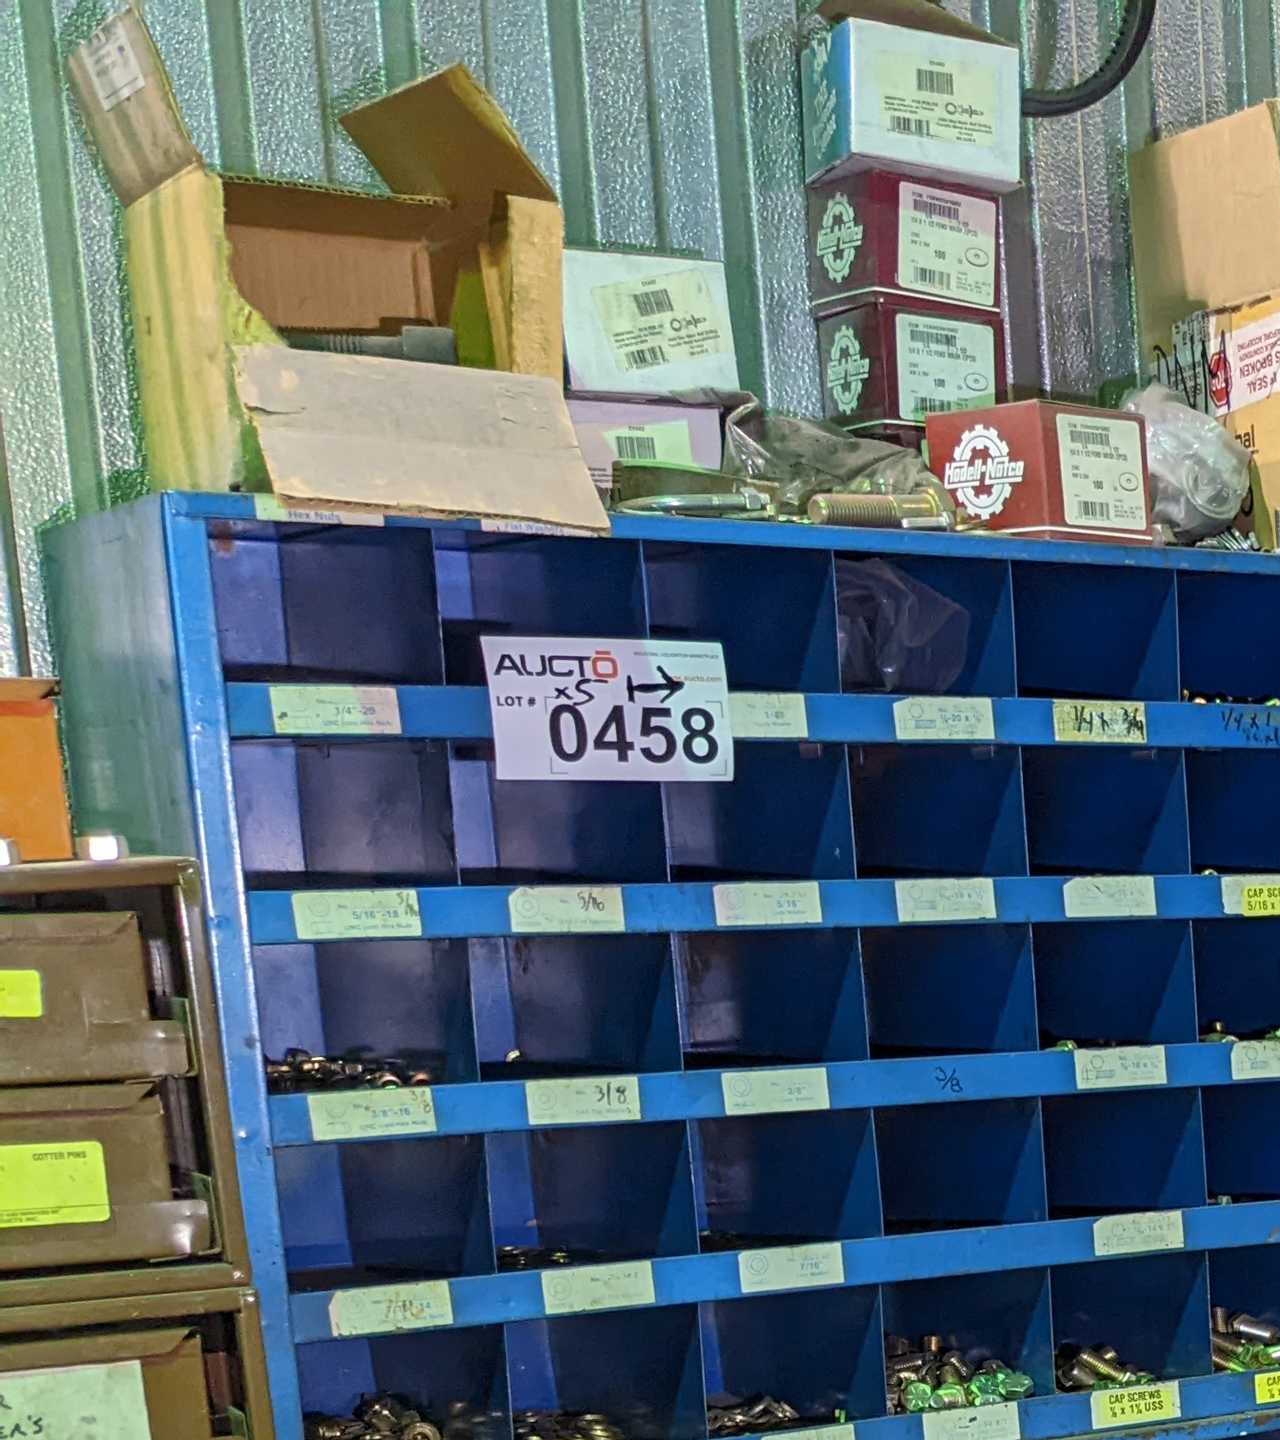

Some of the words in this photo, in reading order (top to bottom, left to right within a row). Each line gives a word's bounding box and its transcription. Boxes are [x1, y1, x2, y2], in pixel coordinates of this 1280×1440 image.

[496, 695, 524, 707] LOT
[527, 695, 537, 707] #
[549, 703, 720, 765] 0458
[1247, 887, 1264, 899] CAP
[1247, 900, 1268, 912] 5/16
[935, 1065, 963, 1093] 3/8
[32, 1151, 65, 1162] COTTER
[66, 1149, 87, 1160] PINS
[1108, 1393, 1126, 1405] CAP
[1127, 1389, 1162, 1402] SCREWS
[1145, 1400, 1164, 1412] USS
